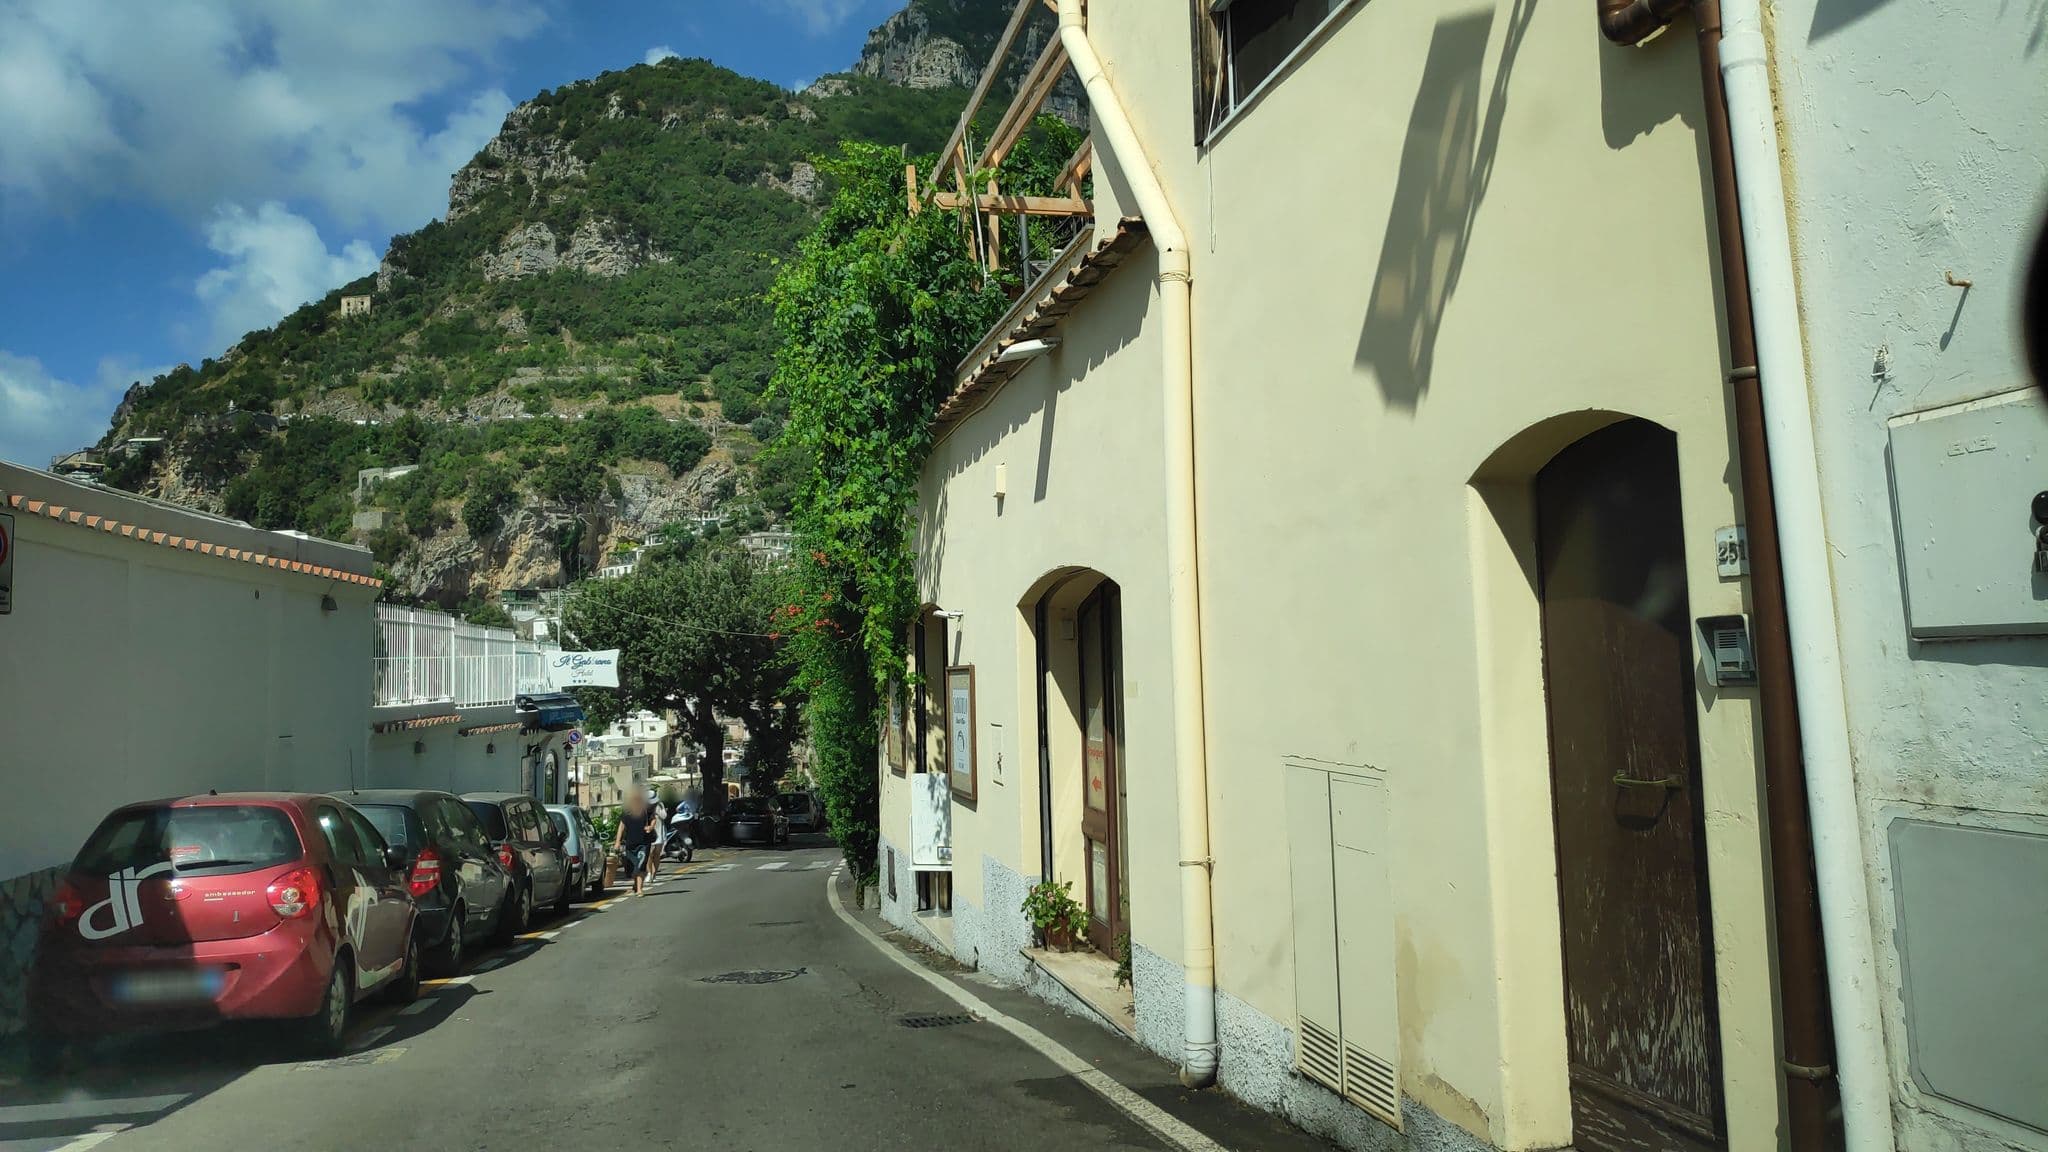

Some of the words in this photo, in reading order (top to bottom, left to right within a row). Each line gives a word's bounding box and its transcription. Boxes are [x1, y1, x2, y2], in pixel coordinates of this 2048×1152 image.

[1947, 435, 1997, 457] ENEL
[1718, 540, 1746, 565] 251
[571, 654, 612, 669] Gabiano
